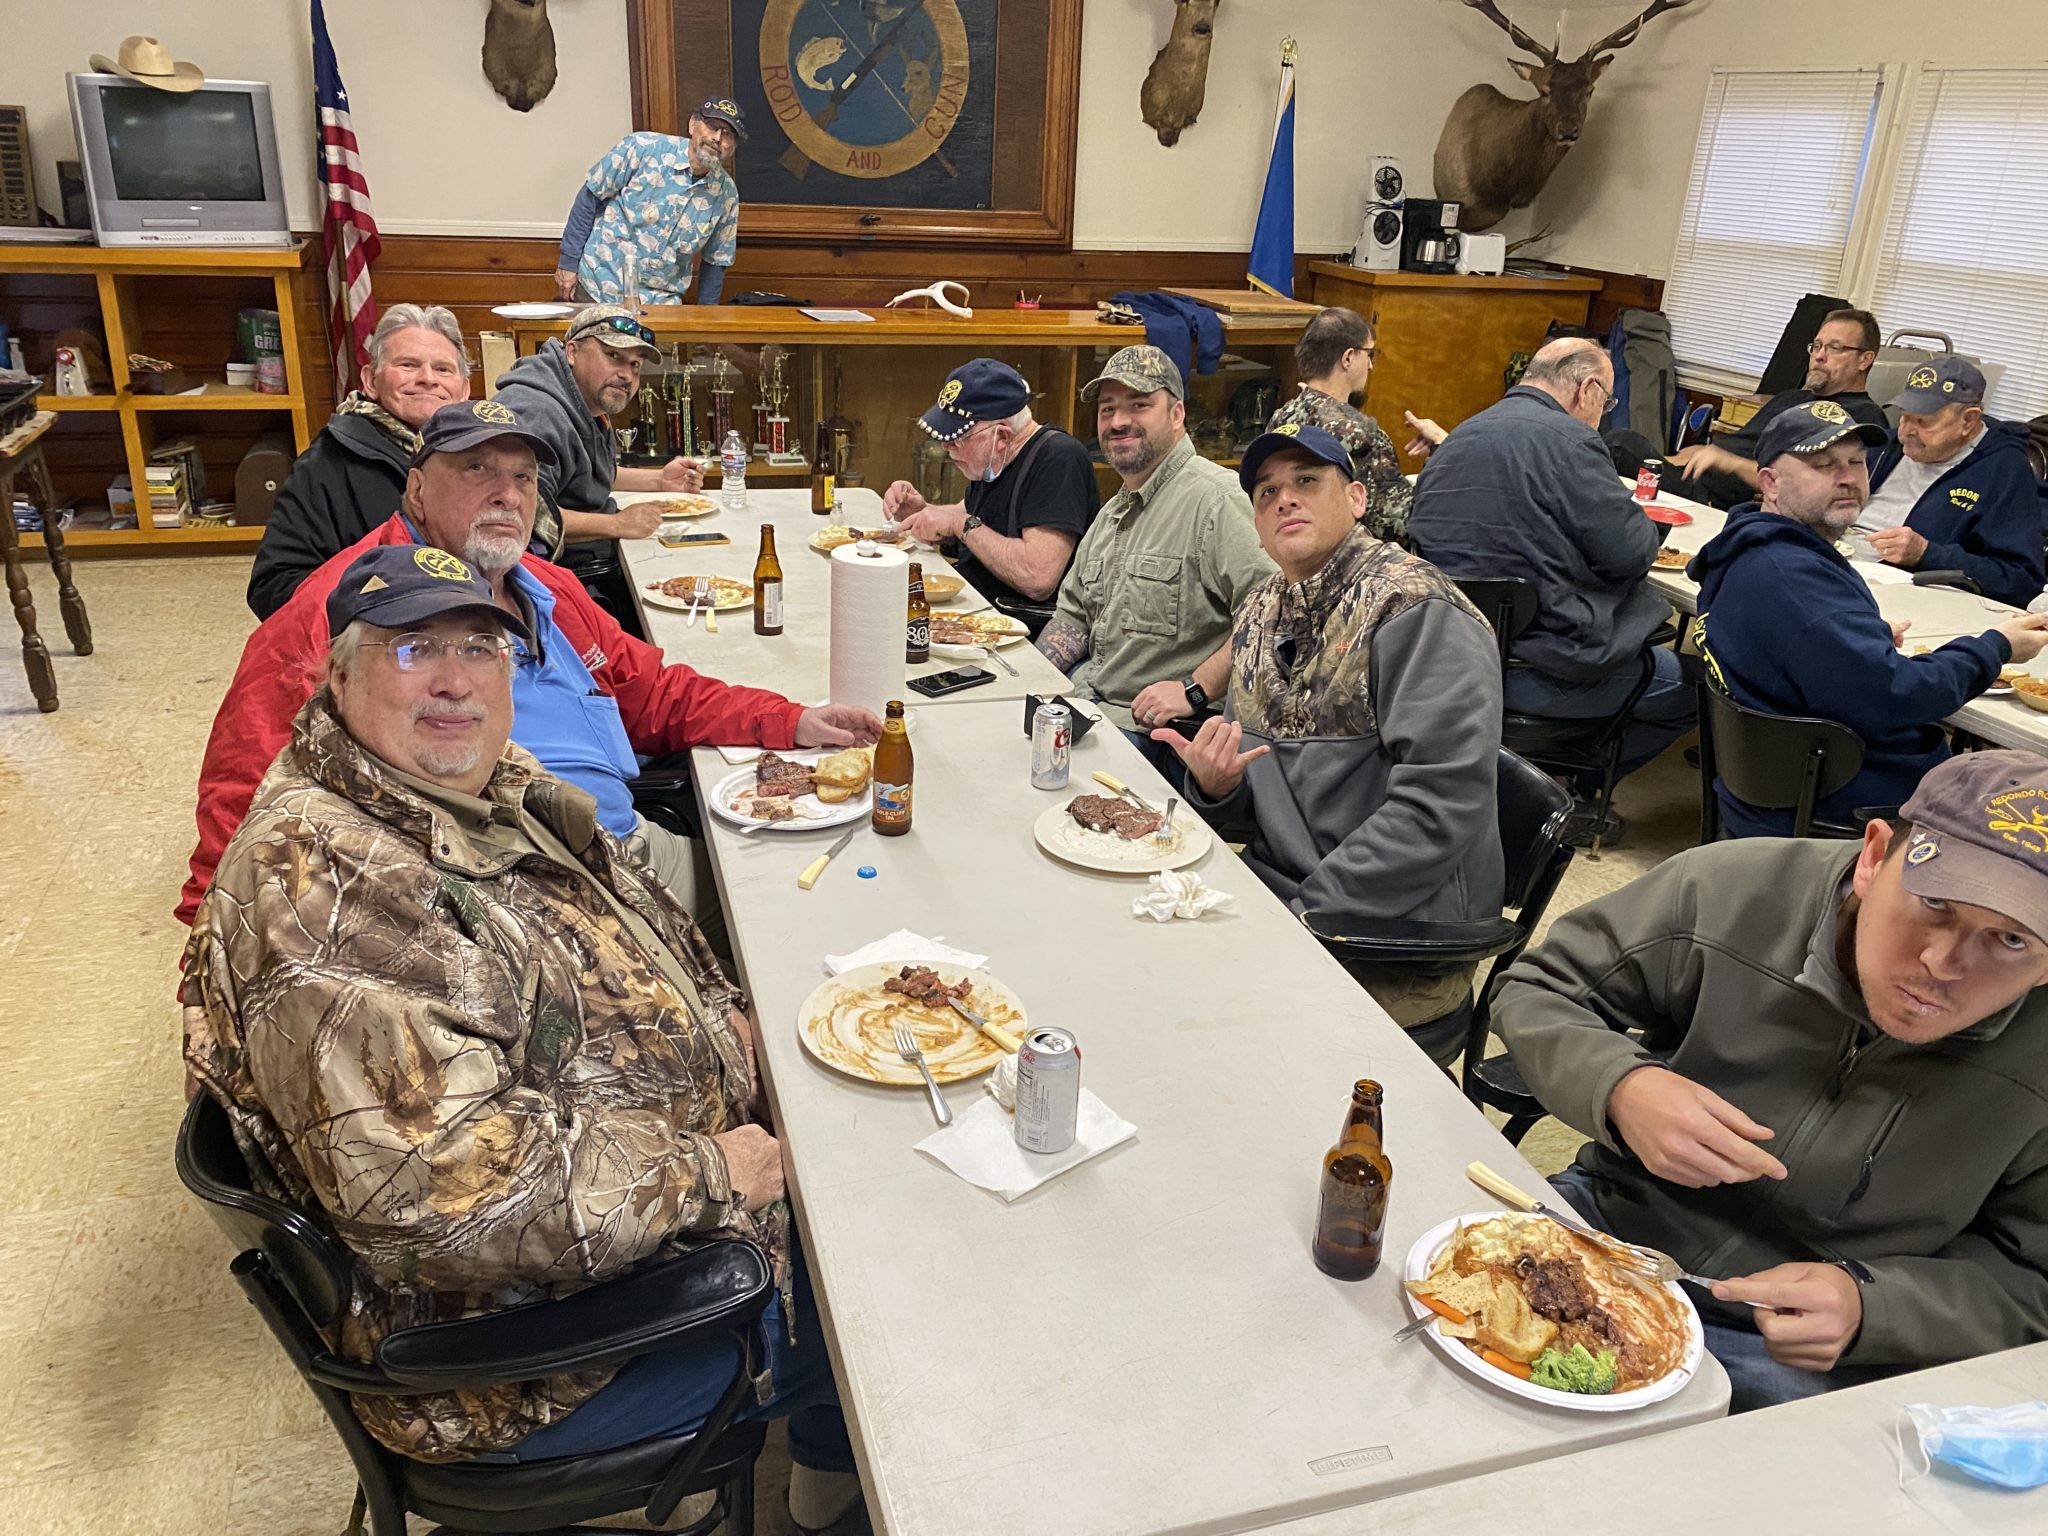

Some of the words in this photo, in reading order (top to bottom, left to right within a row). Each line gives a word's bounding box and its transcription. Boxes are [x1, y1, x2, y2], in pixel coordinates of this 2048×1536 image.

[762, 64, 802, 123] ROD
[846, 150, 882, 170] AND
[924, 65, 967, 140] GUN
[1949, 488, 1980, 502] REDON
[1991, 789, 2036, 806] REDONDO
[1315, 1450, 1387, 1471] LIFETIME
